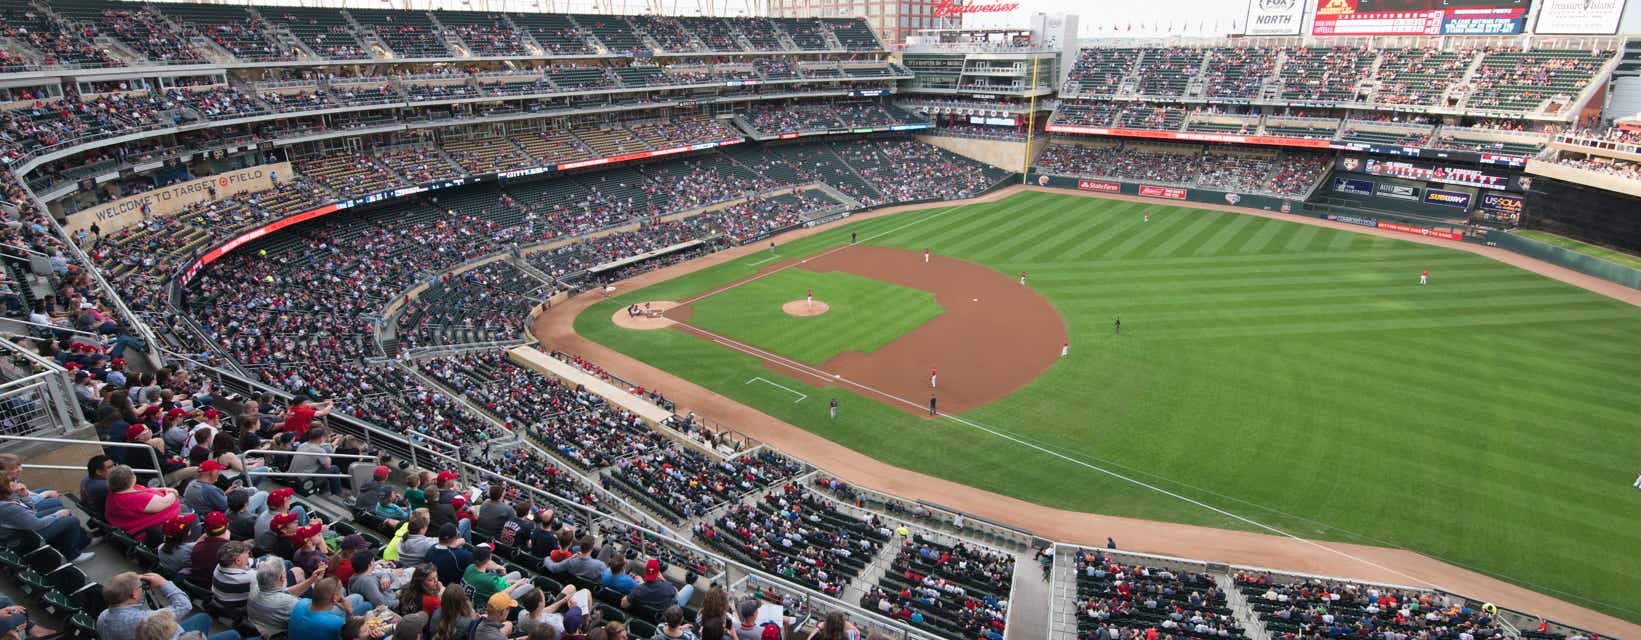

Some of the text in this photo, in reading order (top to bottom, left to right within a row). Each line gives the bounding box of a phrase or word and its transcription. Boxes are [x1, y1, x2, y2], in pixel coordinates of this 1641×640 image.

[931, 0, 1019, 17] Budweiser
[1256, 15, 1292, 24] NORTH
[95, 170, 263, 222] WELCOME TO TARGET FIELD
[1427, 192, 1466, 203] SUBWAY
